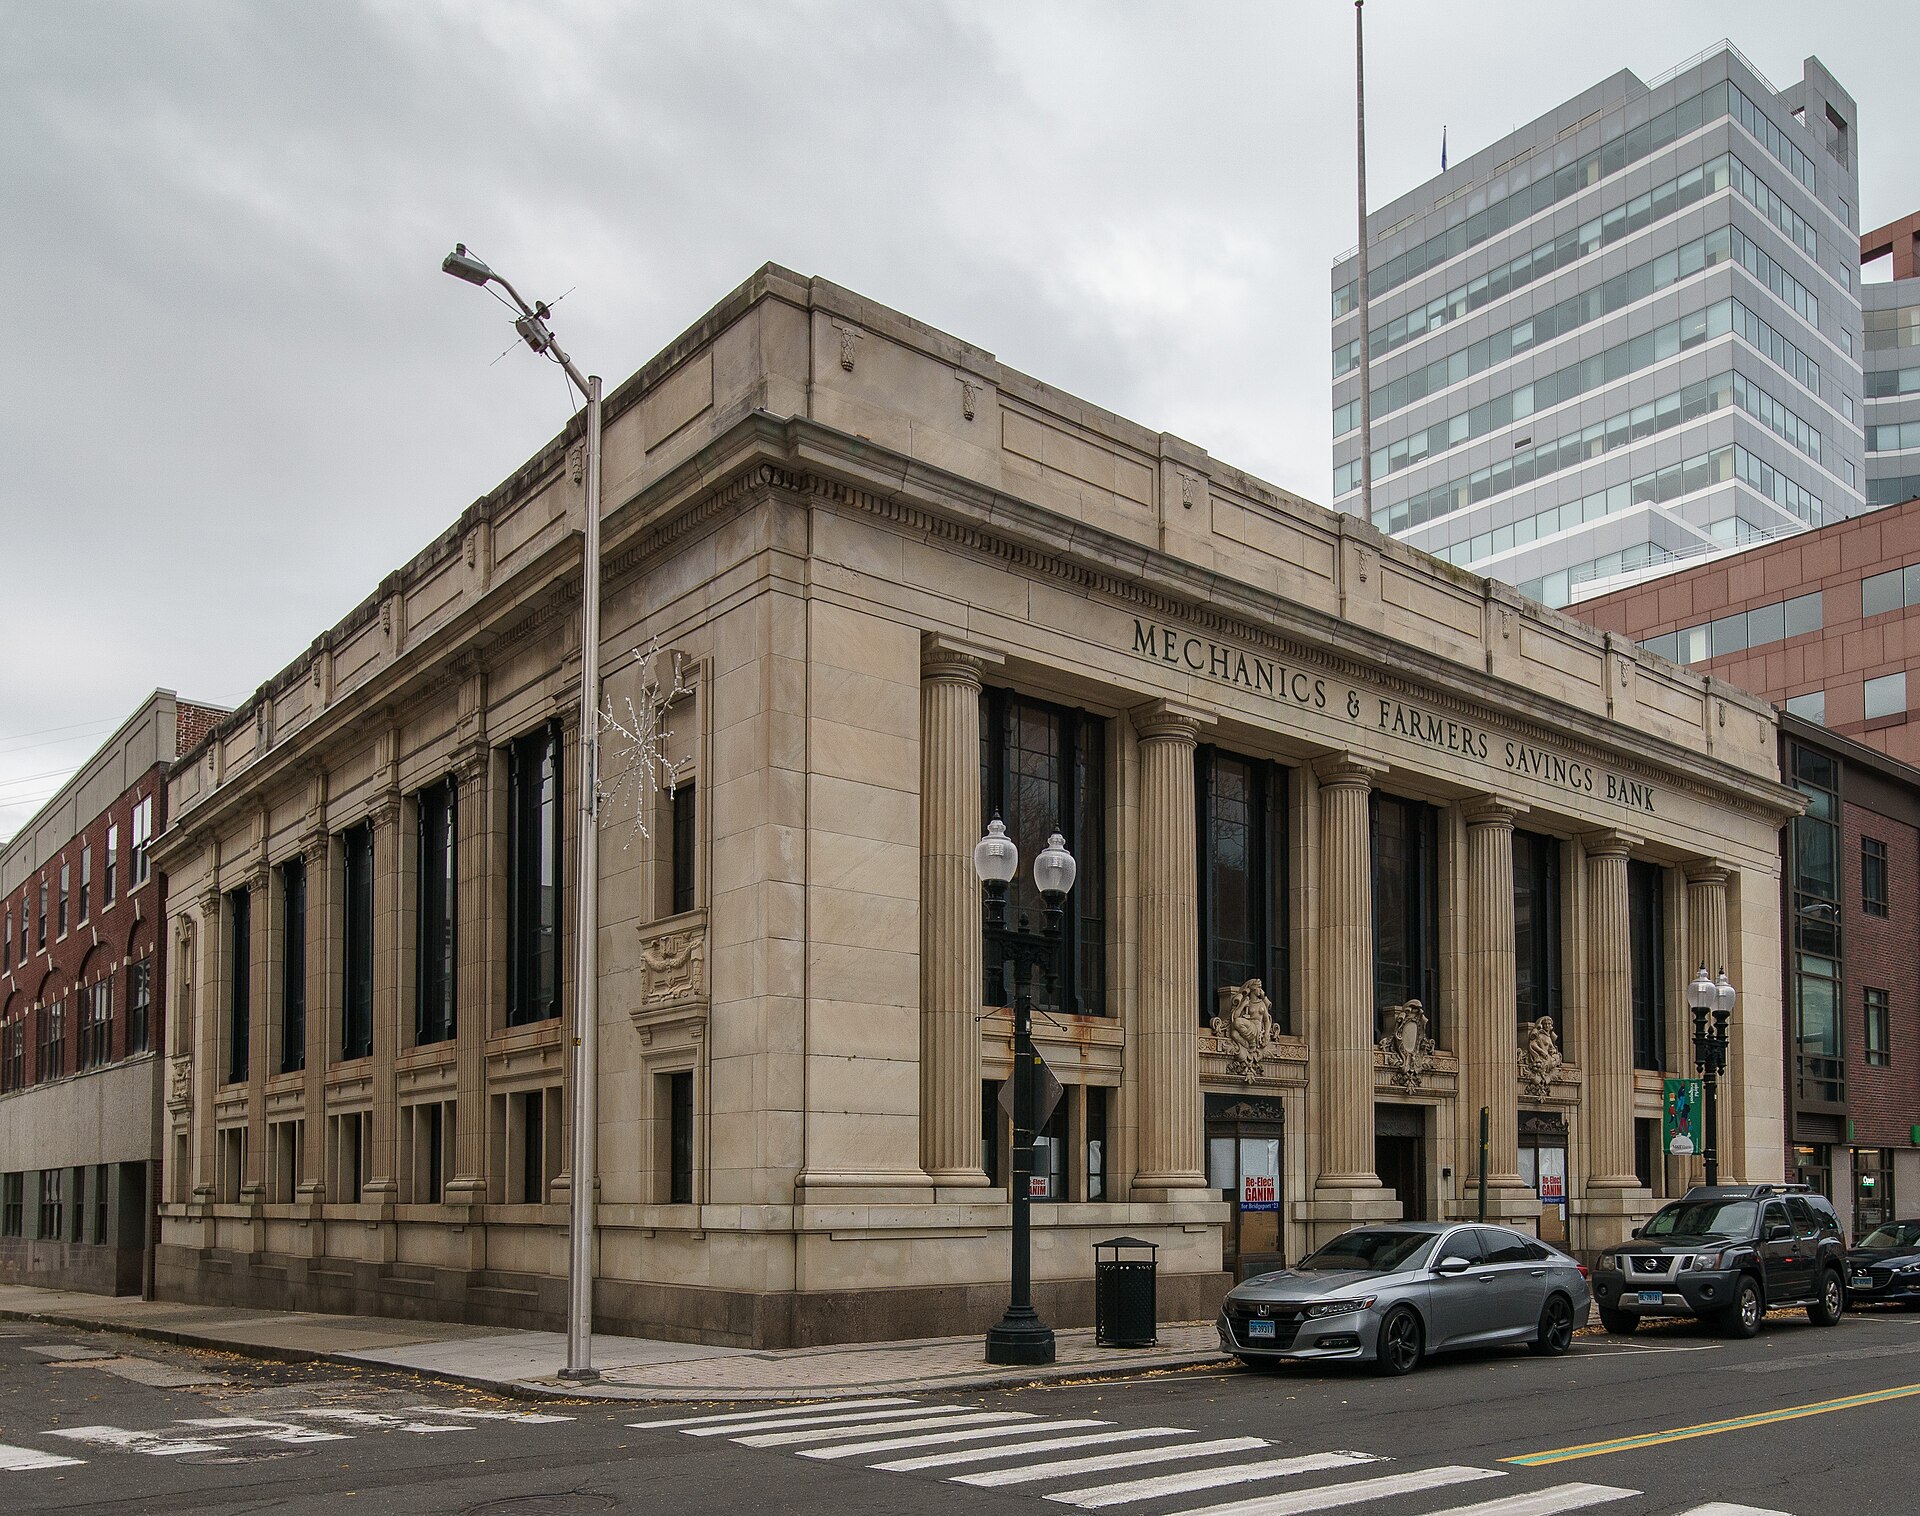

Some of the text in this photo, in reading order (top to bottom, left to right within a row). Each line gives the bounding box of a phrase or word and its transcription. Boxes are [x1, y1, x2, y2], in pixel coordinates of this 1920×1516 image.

[1131, 618, 1655, 812] MECHANICS & FARMERS SAVINGS BANK
[1245, 1177, 1274, 1186] Re-Elect
[1862, 1175, 1875, 1185] Open
[1029, 1185, 1046, 1196] ANIM
[1245, 1187, 1275, 1201] GANIM
[1542, 1184, 1562, 1196] GANIM
